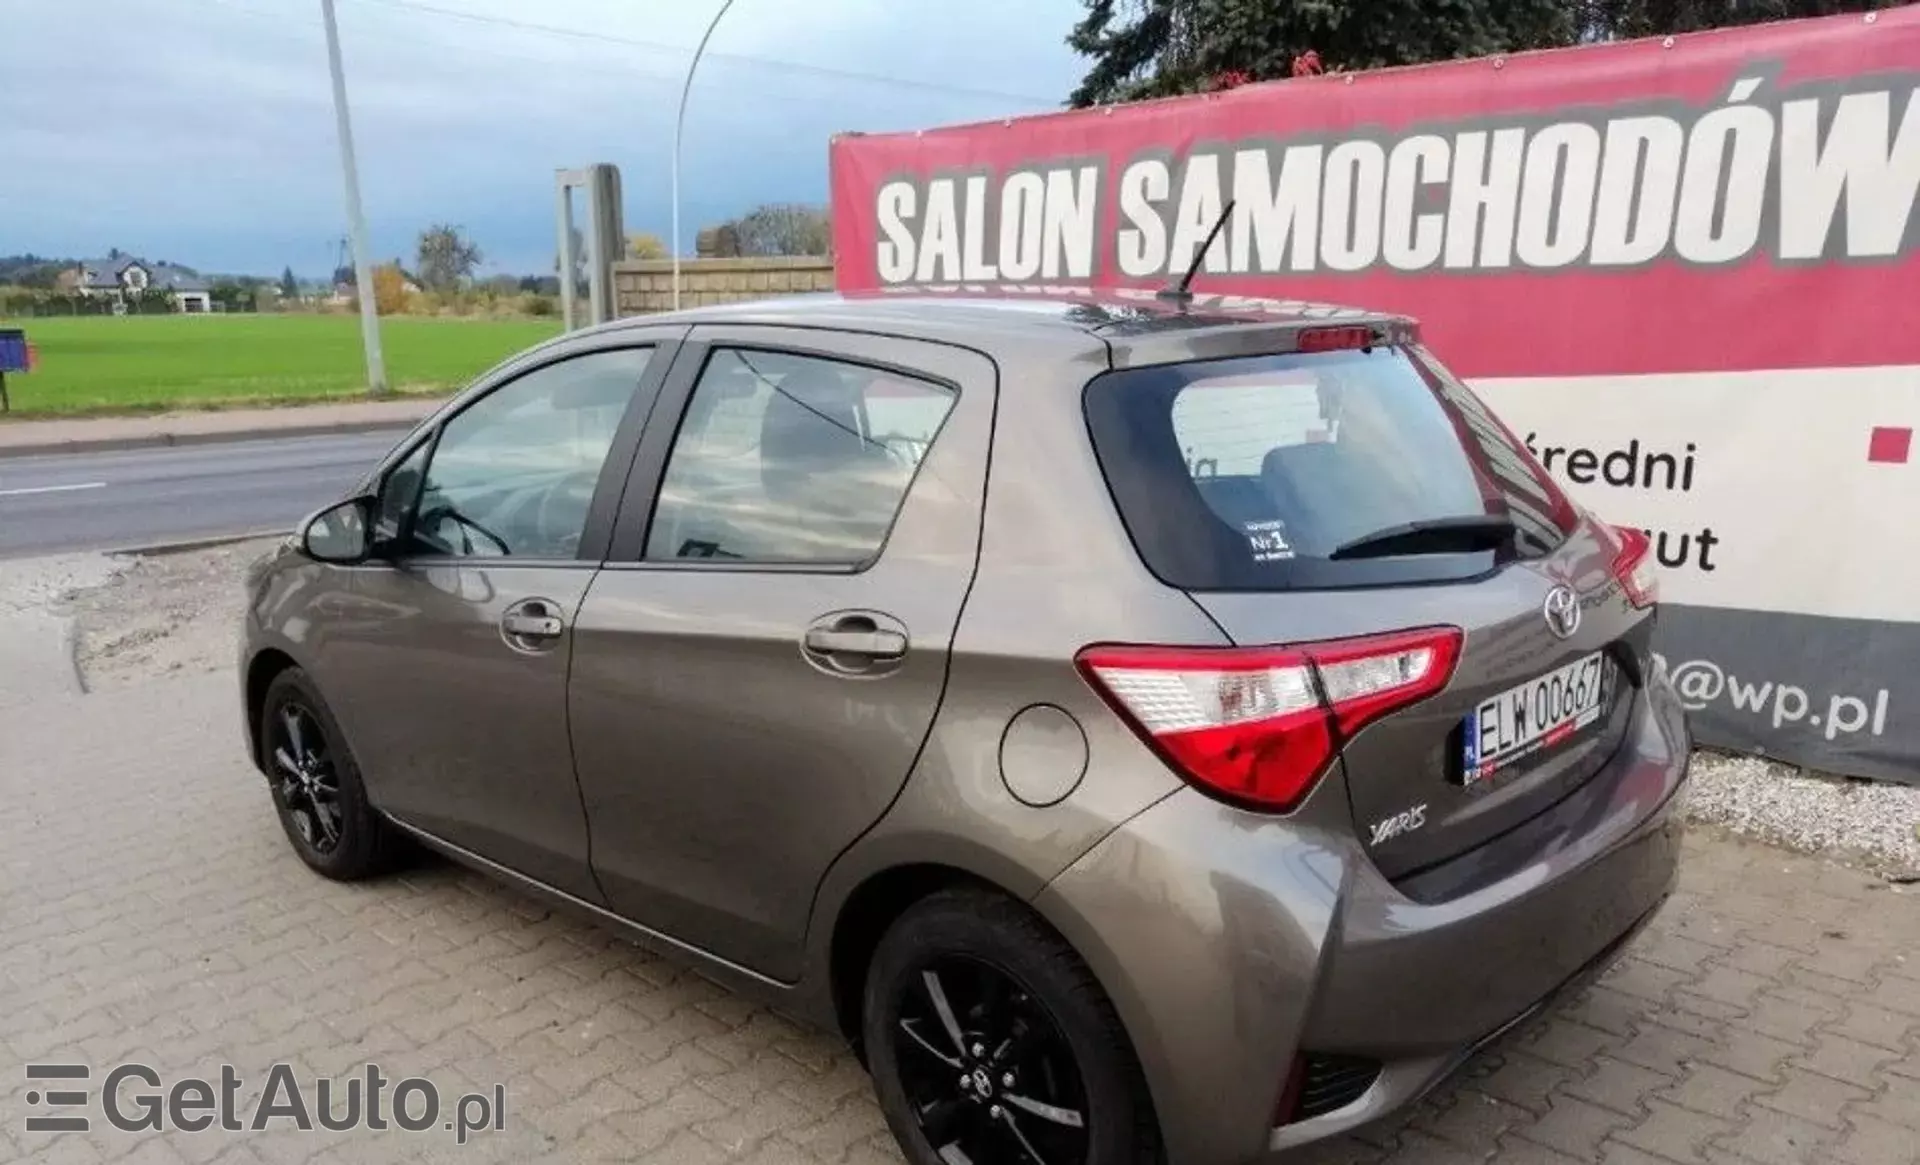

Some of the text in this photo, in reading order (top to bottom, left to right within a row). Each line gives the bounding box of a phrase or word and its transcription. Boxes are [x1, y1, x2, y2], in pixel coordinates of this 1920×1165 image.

[876, 77, 1920, 283] SALON SAMOCHODÓW
[1644, 527, 1719, 572] ut
[1480, 687, 1528, 757] ELW
[1534, 657, 1601, 731] 00667
[1654, 653, 1890, 741] @wp.pl
[1369, 803, 1428, 847] YARIS
